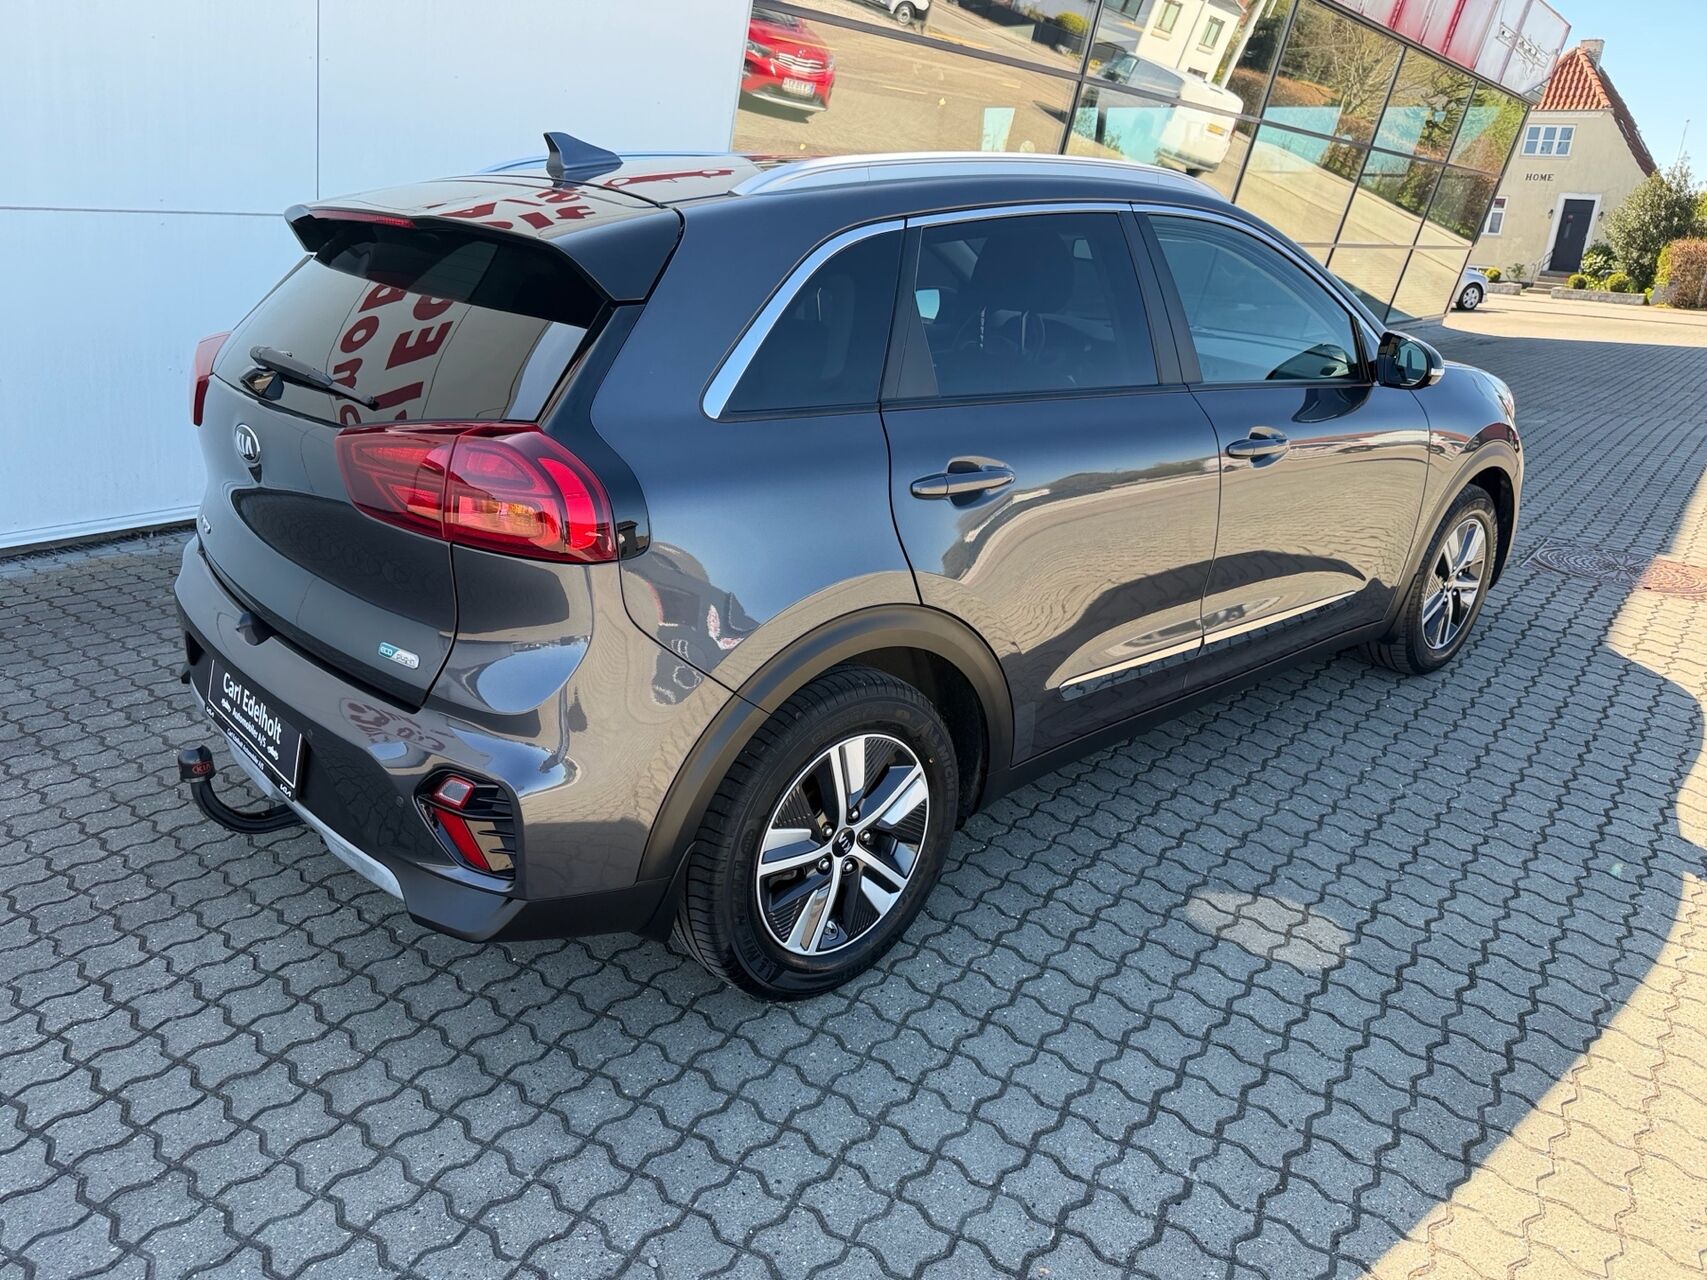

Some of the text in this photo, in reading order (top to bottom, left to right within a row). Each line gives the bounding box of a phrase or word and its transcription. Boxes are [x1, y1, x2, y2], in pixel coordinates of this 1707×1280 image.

[1525, 173, 1555, 182] HOME
[223, 672, 282, 744] Carl Edelholt
[838, 832, 852, 853] KIA
